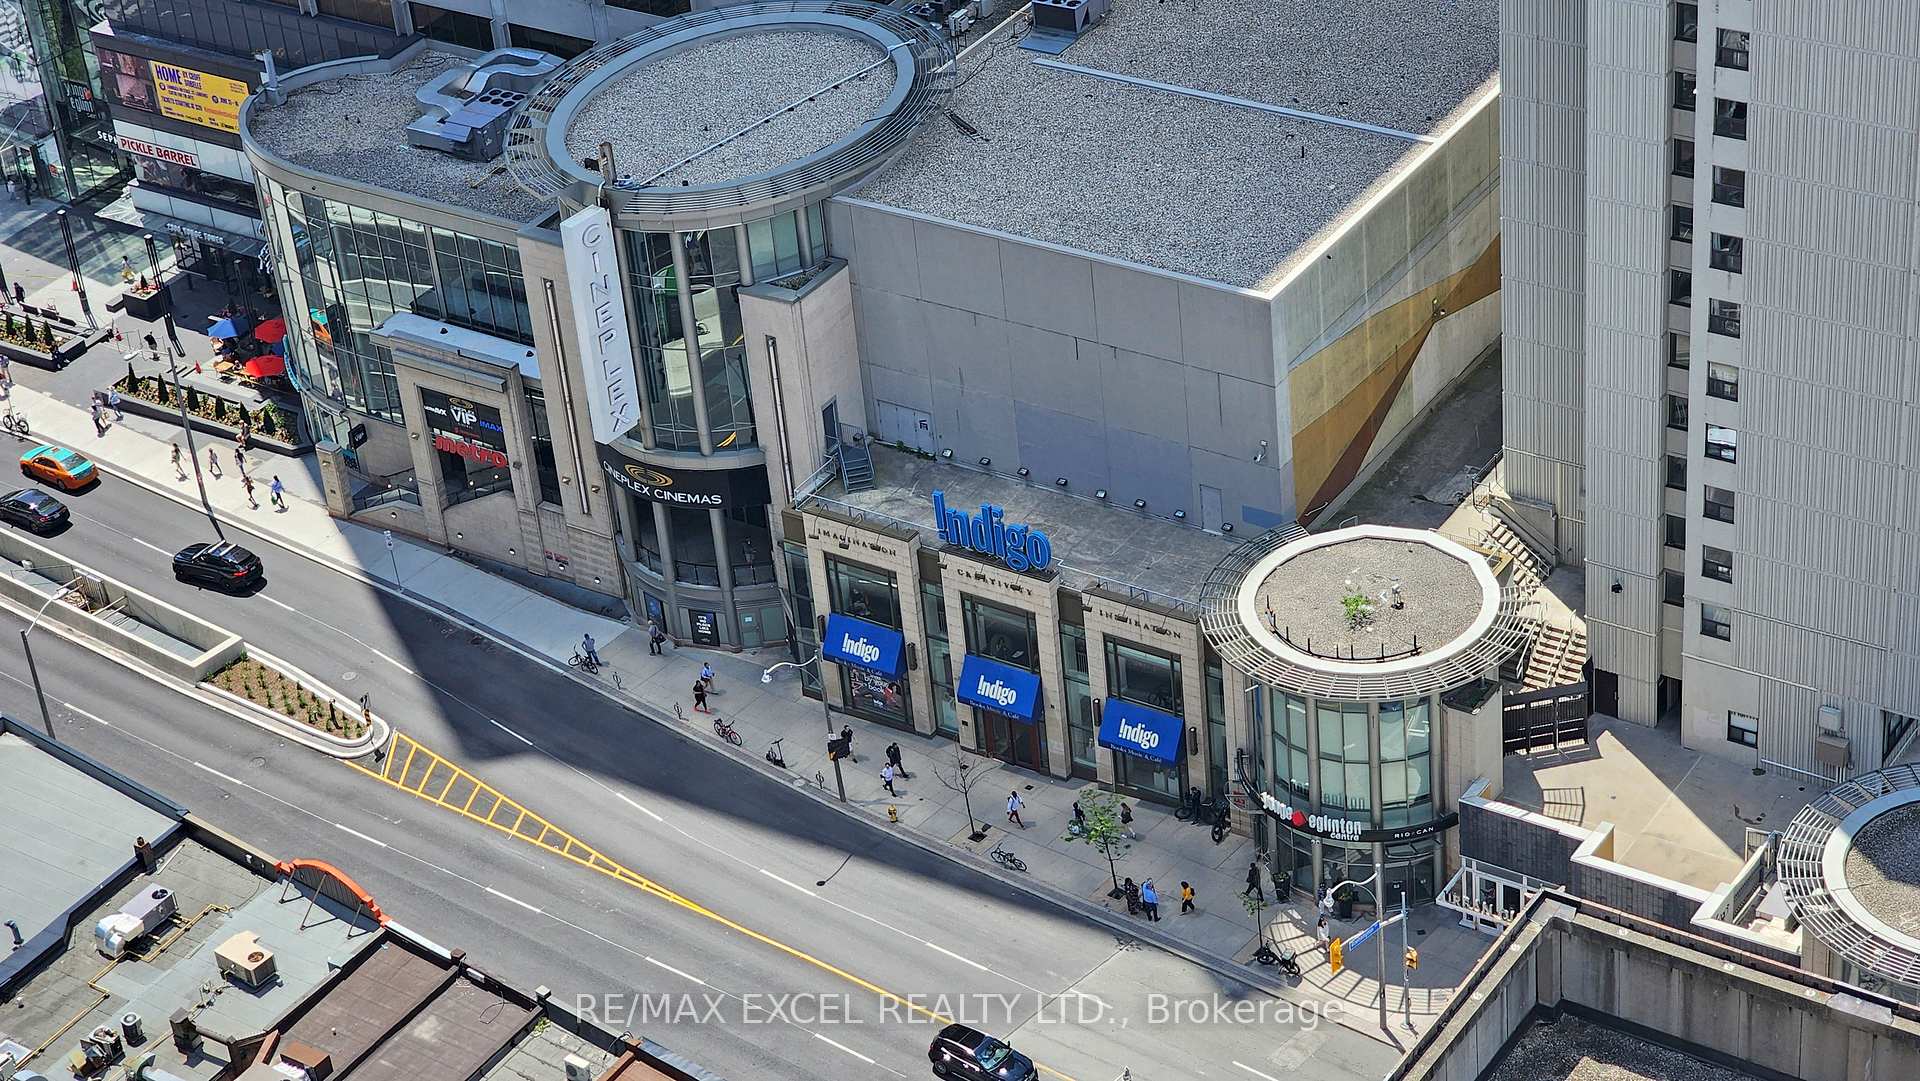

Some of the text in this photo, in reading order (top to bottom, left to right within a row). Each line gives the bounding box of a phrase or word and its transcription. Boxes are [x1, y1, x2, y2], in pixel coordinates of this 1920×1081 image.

[155, 64, 182, 85] HOME
[121, 138, 197, 167] PICKLE BARREL
[581, 223, 629, 433] CINEPLEX
[450, 408, 477, 425] VIP
[480, 420, 504, 433] IMAX
[435, 435, 508, 469] metro
[603, 460, 723, 505] CINEPLEX CINEMAS
[1308, 814, 1362, 836] eglinton
[1330, 832, 1360, 842] centre
